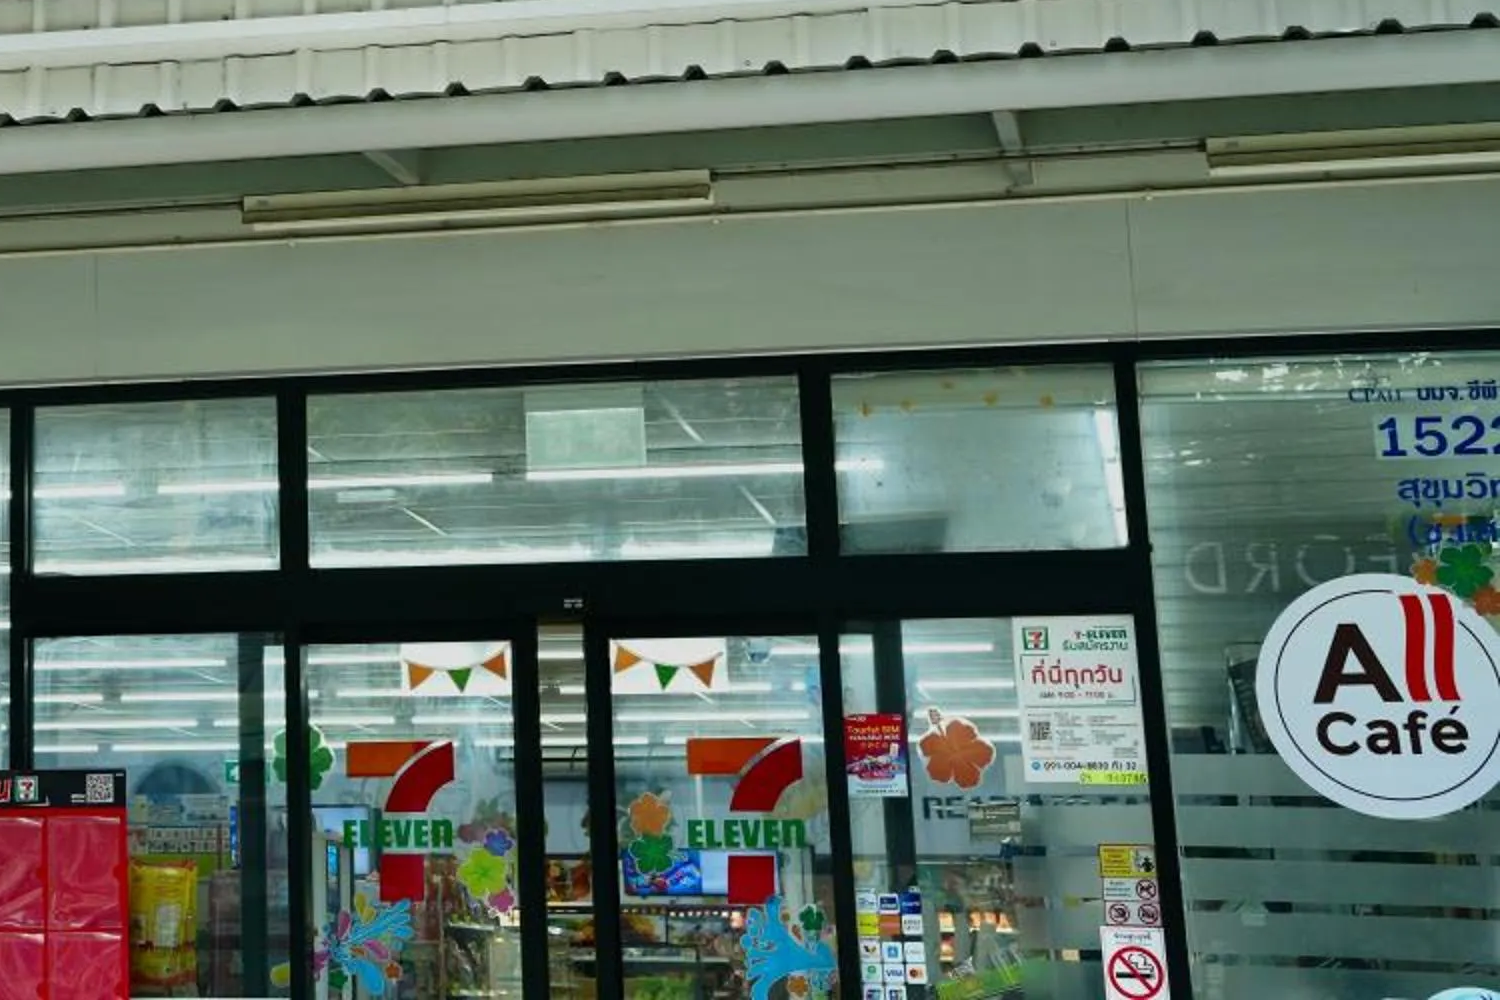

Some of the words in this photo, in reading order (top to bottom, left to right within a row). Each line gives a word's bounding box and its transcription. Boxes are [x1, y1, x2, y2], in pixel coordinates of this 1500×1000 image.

[1031, 658, 1123, 689] ที่นี่ทุกวัน
[1313, 593, 1461, 703] All
[1316, 706, 1469, 756] Café
[346, 741, 455, 902] 7
[687, 738, 804, 905] 7
